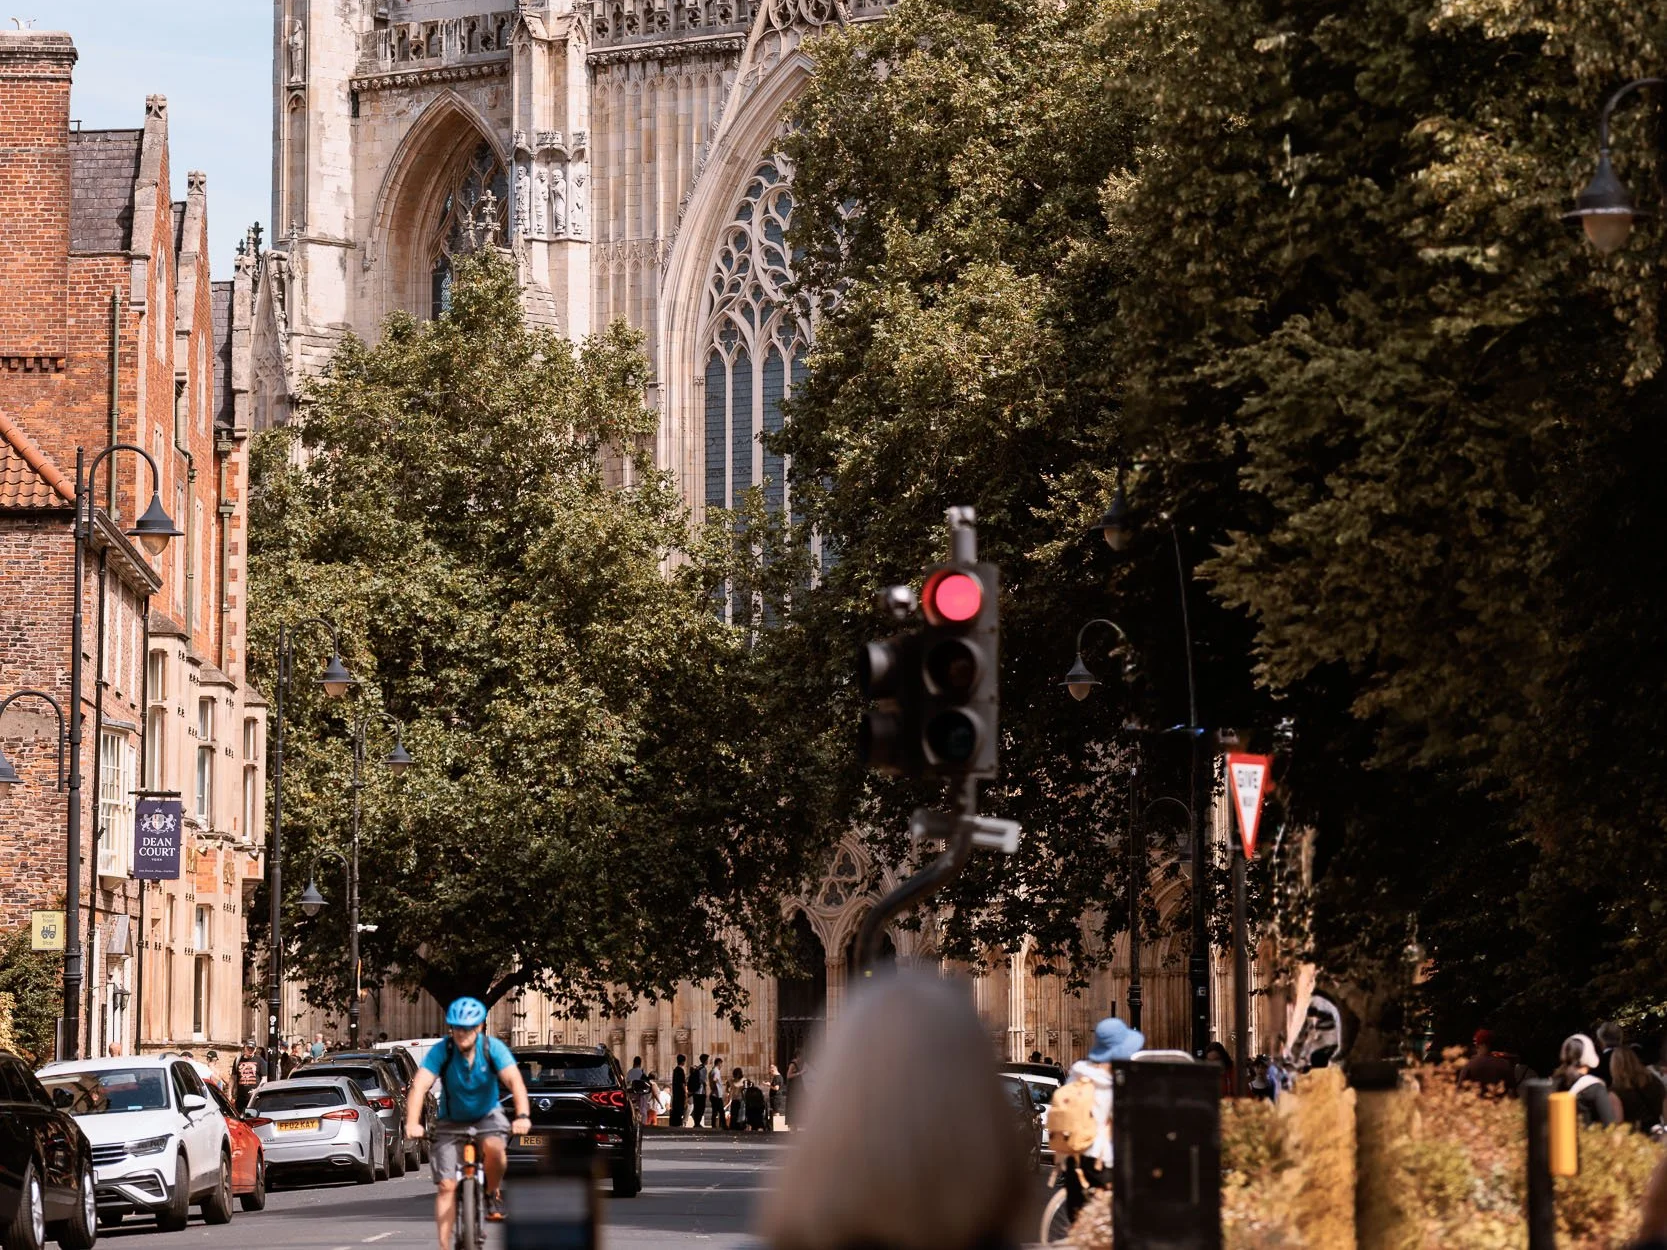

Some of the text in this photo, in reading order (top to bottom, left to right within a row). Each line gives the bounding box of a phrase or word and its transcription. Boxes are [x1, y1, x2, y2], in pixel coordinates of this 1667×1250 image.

[142, 837, 172, 846] DEAN
[139, 847, 176, 856] COURT
[300, 1120, 315, 1128] KAY
